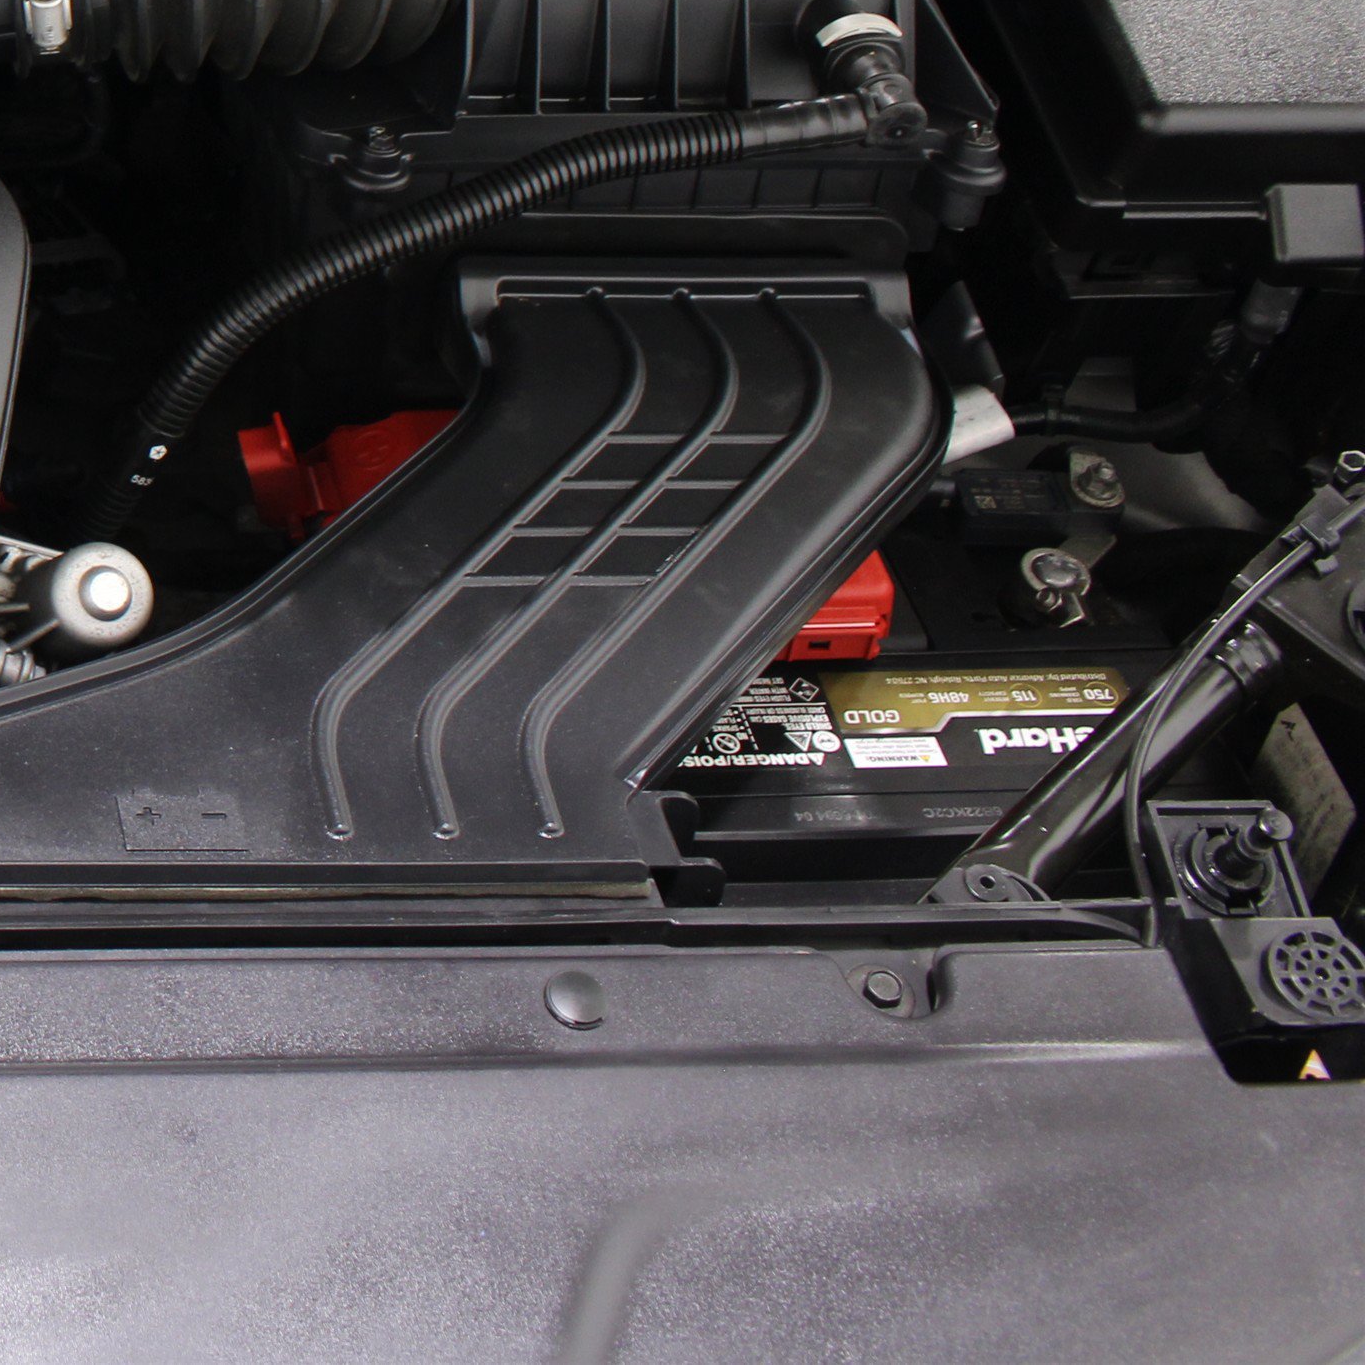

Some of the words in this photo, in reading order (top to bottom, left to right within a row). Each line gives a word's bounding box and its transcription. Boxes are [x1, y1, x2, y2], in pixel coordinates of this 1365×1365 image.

[1060, 673, 1106, 681] Distributed
[927, 691, 969, 703] 48H6
[1011, 690, 1036, 702] 115
[1083, 688, 1114, 700] 750
[844, 709, 900, 724] GOLD
